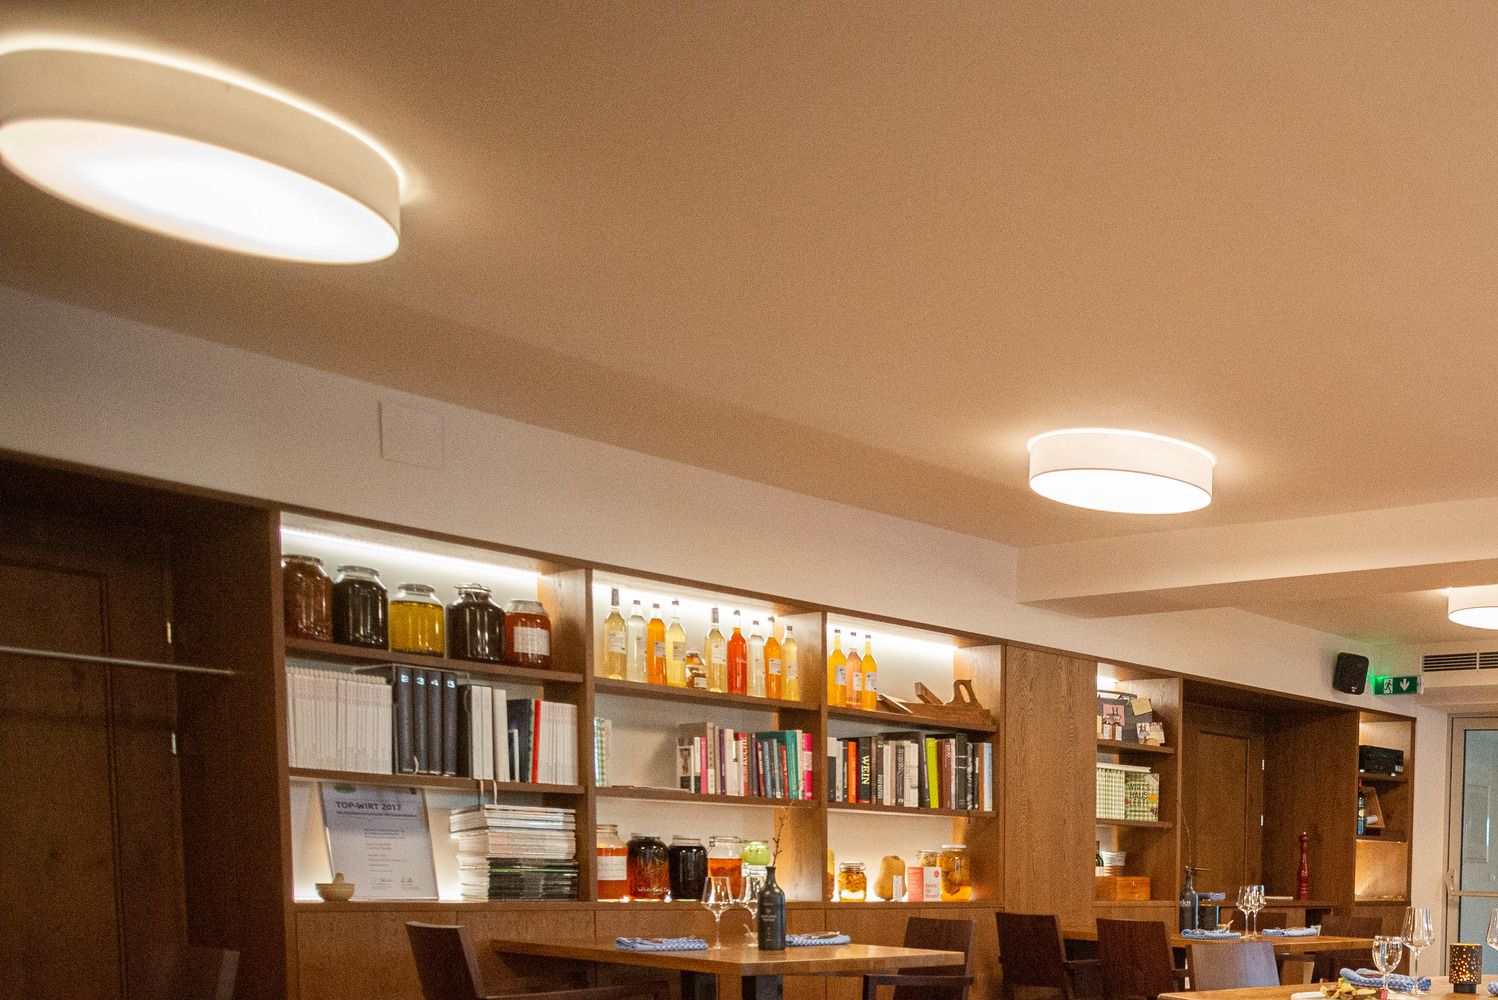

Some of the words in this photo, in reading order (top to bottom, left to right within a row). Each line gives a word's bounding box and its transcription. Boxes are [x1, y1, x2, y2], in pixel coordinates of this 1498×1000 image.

[416, 677, 425, 685] 3
[447, 680, 456, 688] 5
[861, 754, 870, 785] WEIN
[335, 801, 379, 810] TOP-WIRT
[381, 802, 402, 811] 2017
